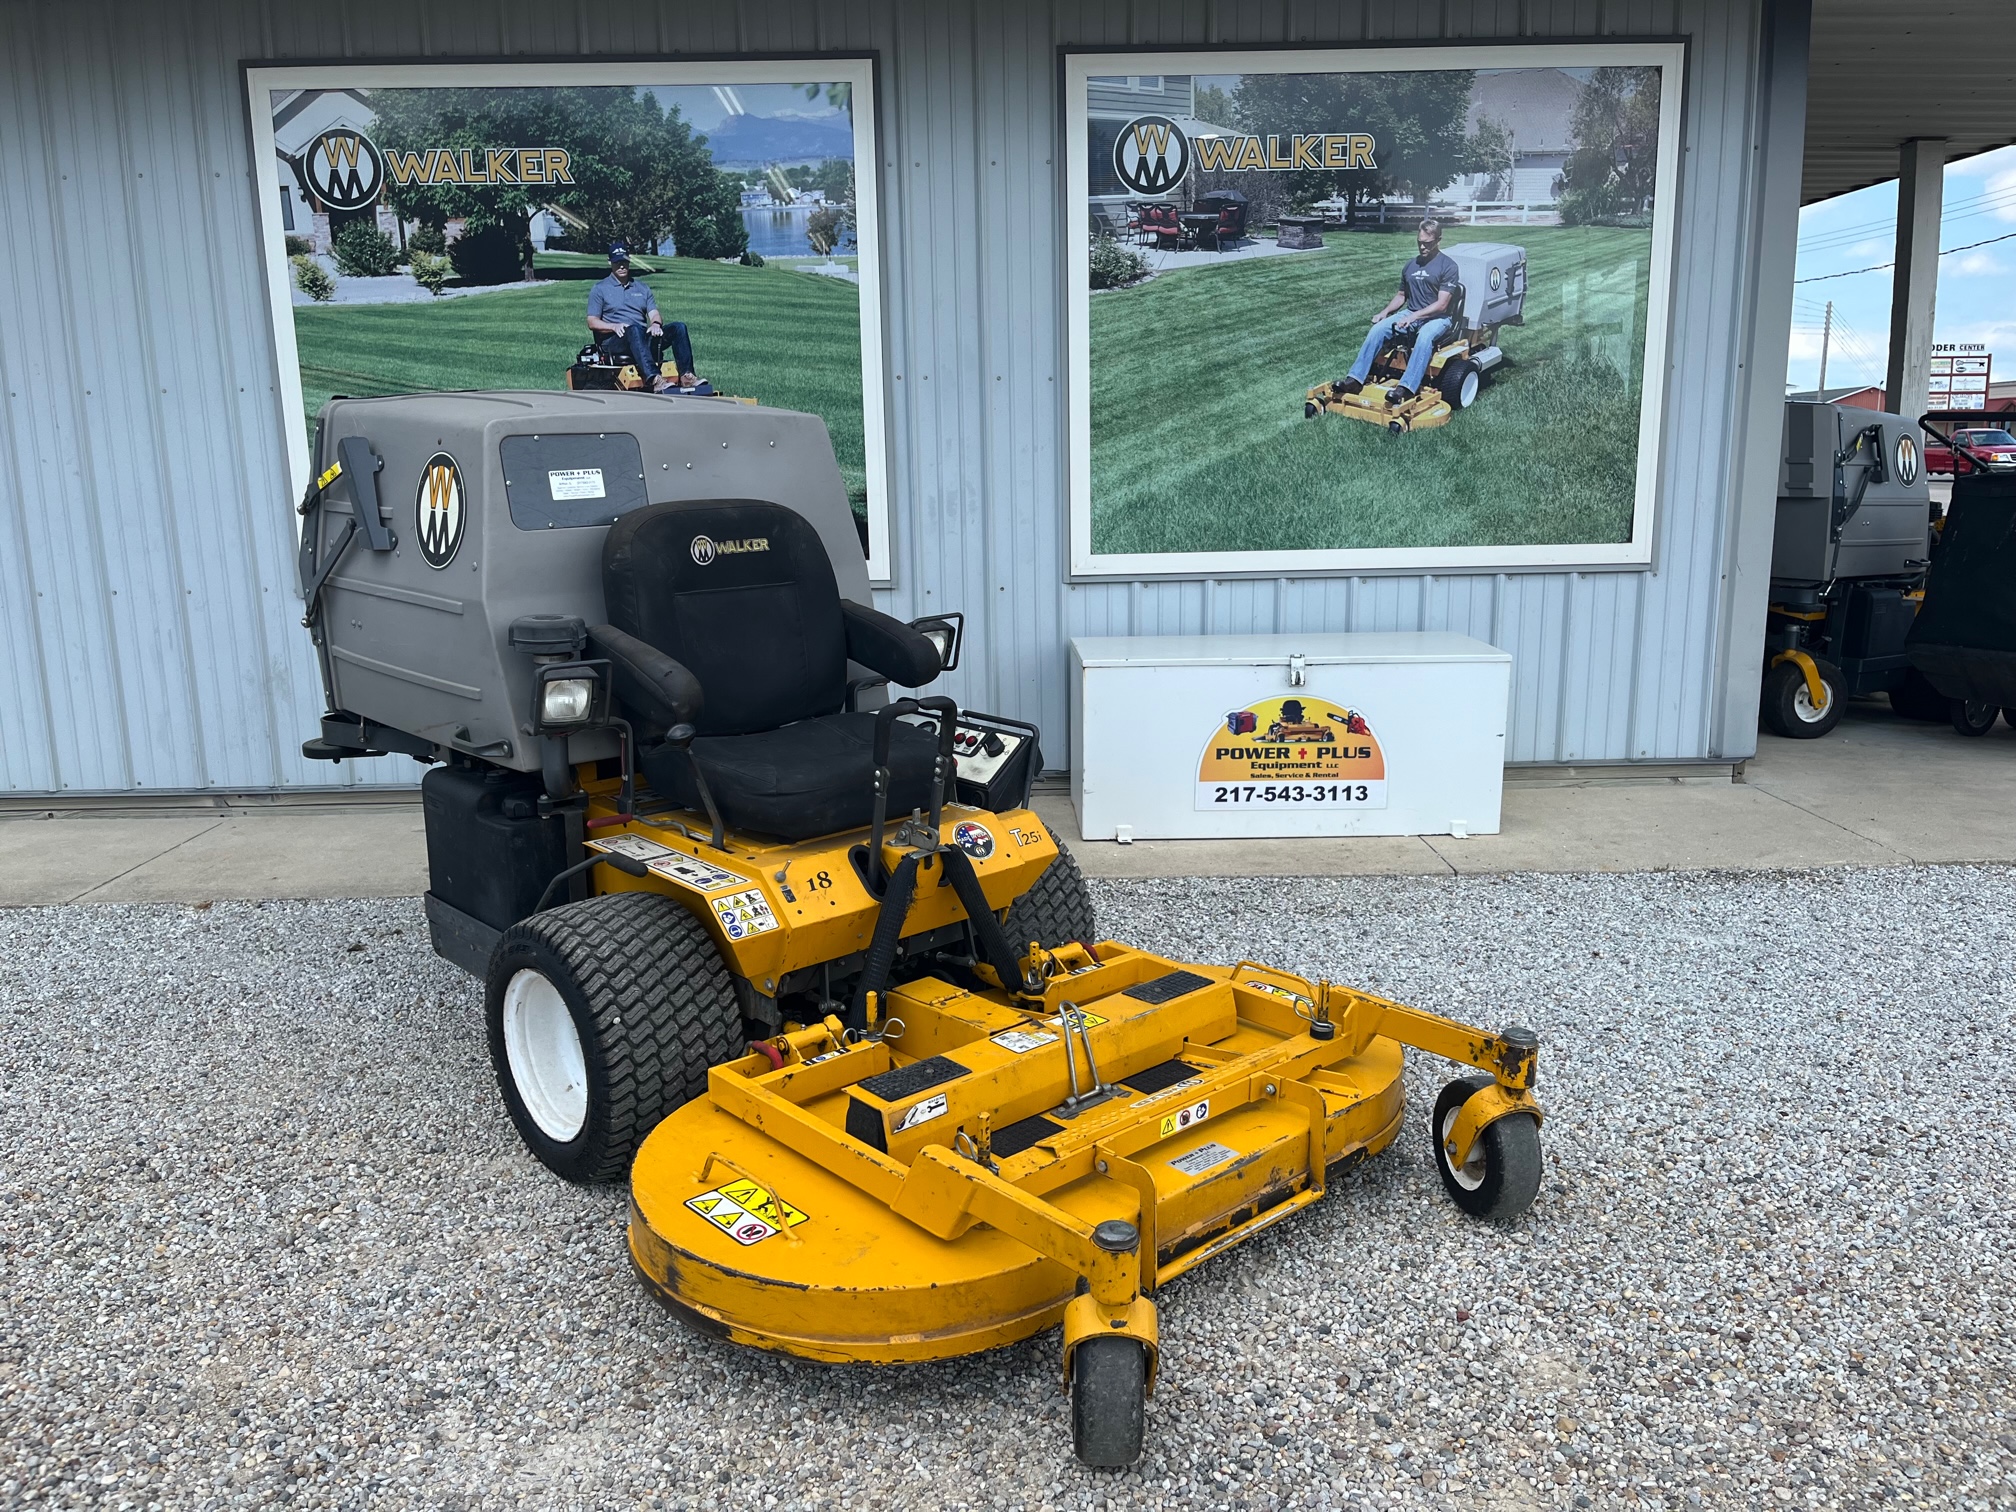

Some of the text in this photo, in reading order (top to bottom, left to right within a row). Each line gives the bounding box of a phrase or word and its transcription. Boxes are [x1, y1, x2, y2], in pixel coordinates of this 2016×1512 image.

[1195, 133, 1378, 172] WALKER
[383, 148, 575, 185] WALKER
[714, 538, 770, 555] WALKER
[1216, 747, 1290, 760] POWER
[1317, 746, 1371, 759] PLUS
[1251, 761, 1322, 771] Equipment
[1214, 785, 1368, 803] 217-543-3113
[1008, 828, 1042, 847] T25i
[806, 871, 833, 892] 18
[1170, 1153, 1195, 1166] POWER
[1198, 1143, 1217, 1153] PLUS
